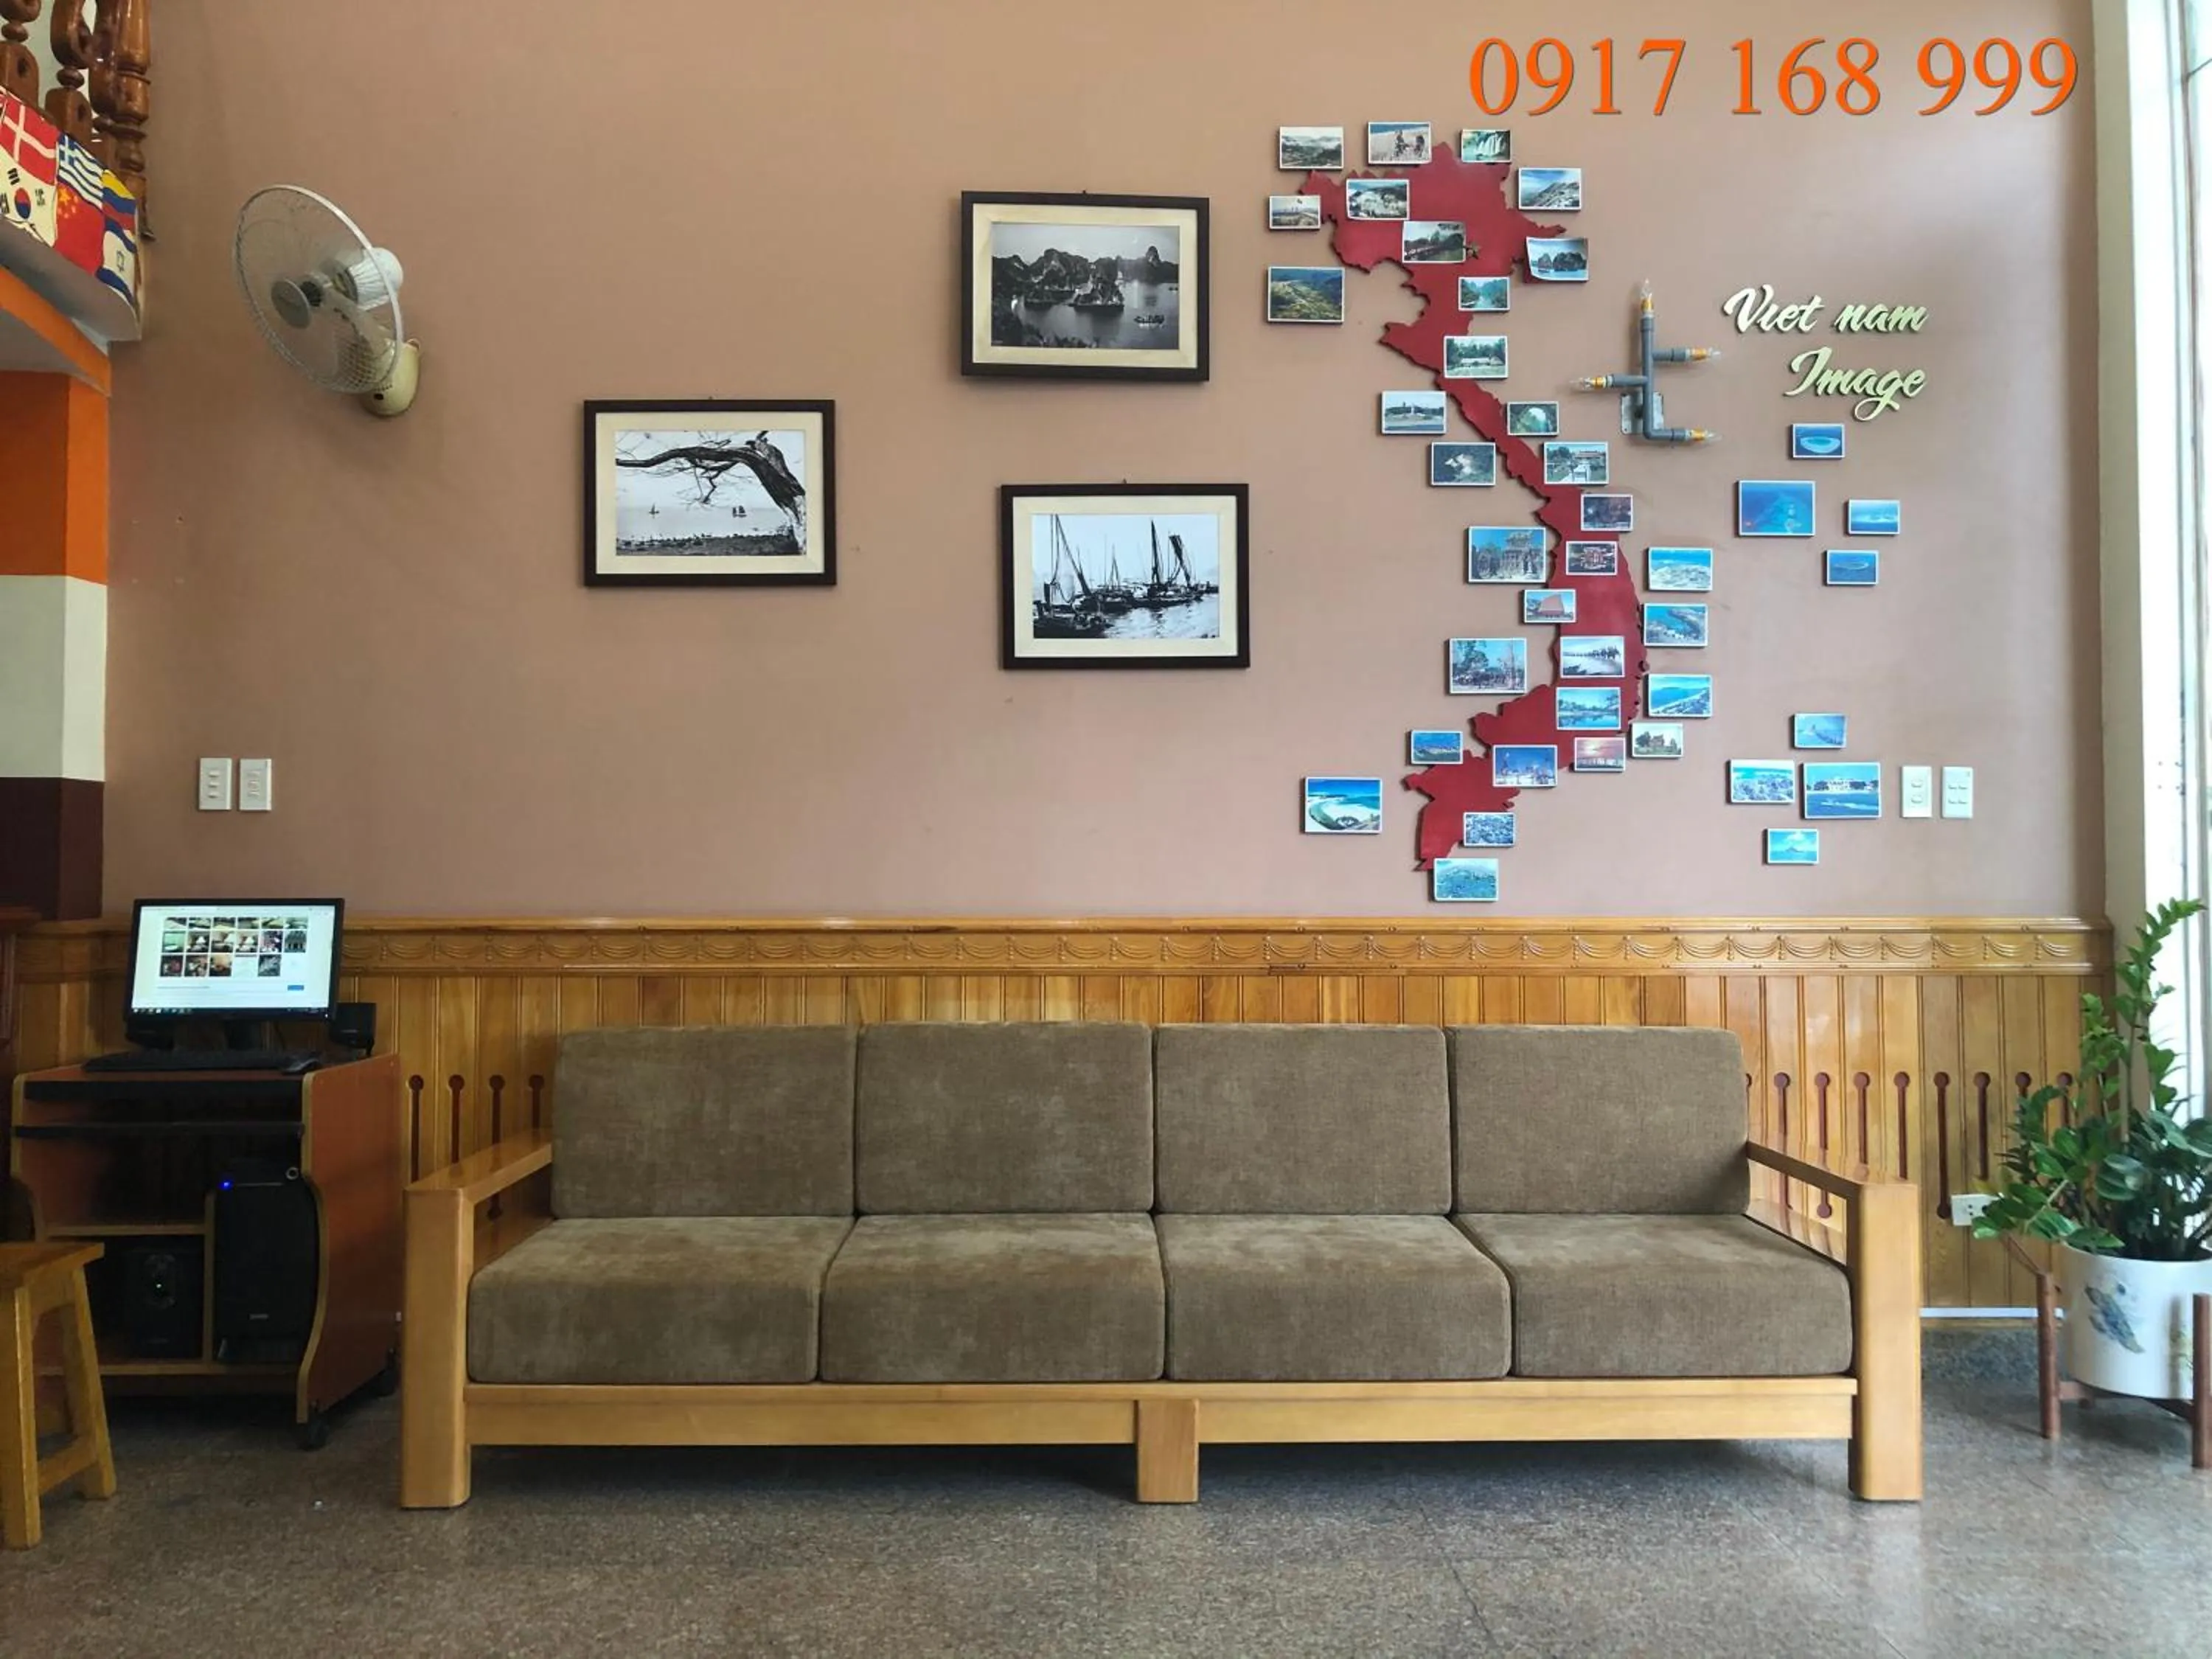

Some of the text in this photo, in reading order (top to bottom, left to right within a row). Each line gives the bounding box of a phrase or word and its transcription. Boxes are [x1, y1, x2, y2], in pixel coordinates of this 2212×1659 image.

[1723, 285, 1927, 333] Viet nam
[1785, 347, 1926, 422] Image
